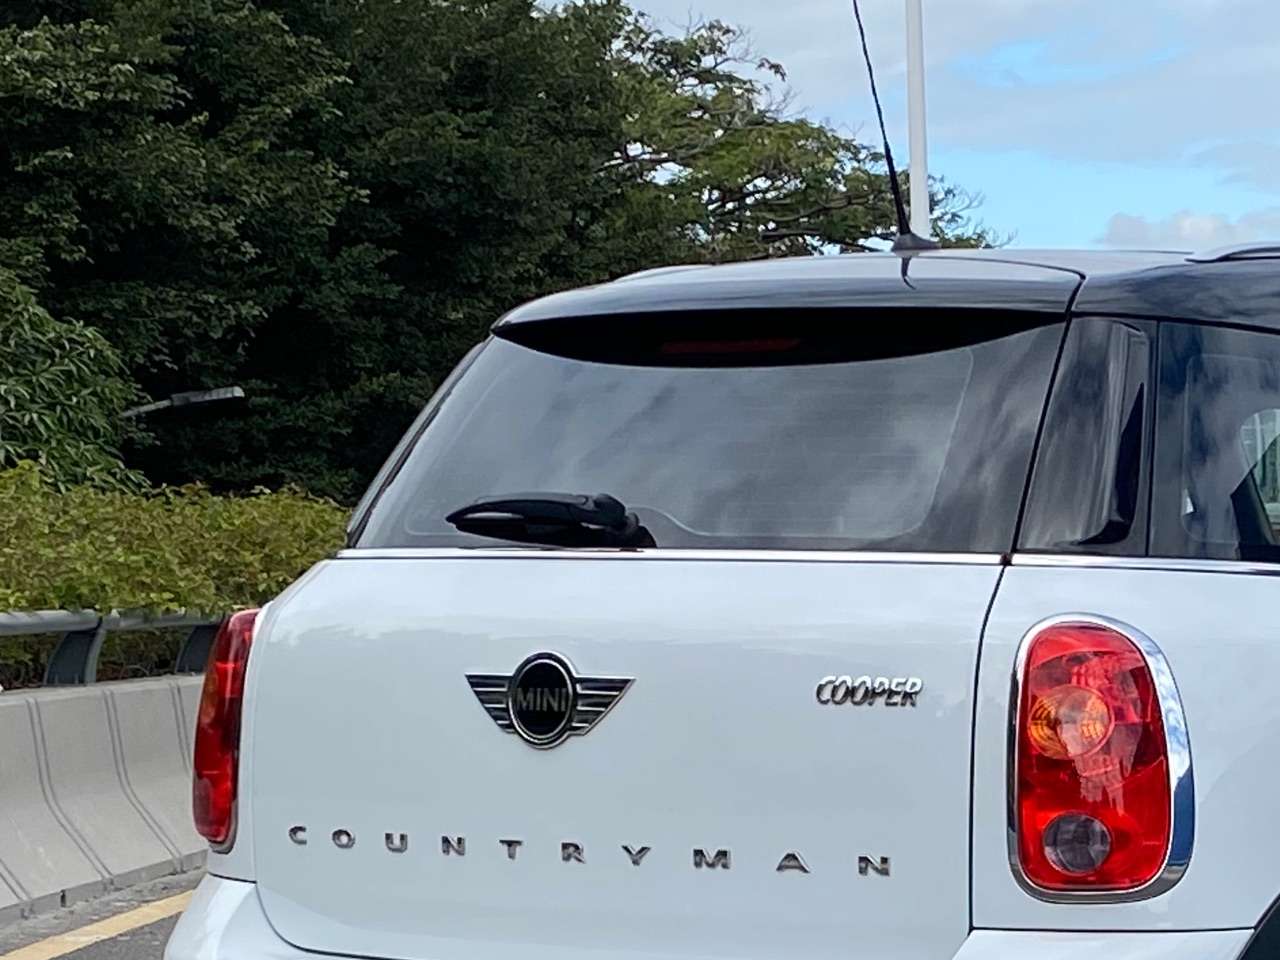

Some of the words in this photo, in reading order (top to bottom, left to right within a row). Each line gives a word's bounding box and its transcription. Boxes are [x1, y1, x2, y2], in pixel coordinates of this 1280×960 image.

[514, 687, 568, 712] MINI
[816, 675, 923, 707] COOPER
[289, 825, 891, 877] COUNTRYMAN
